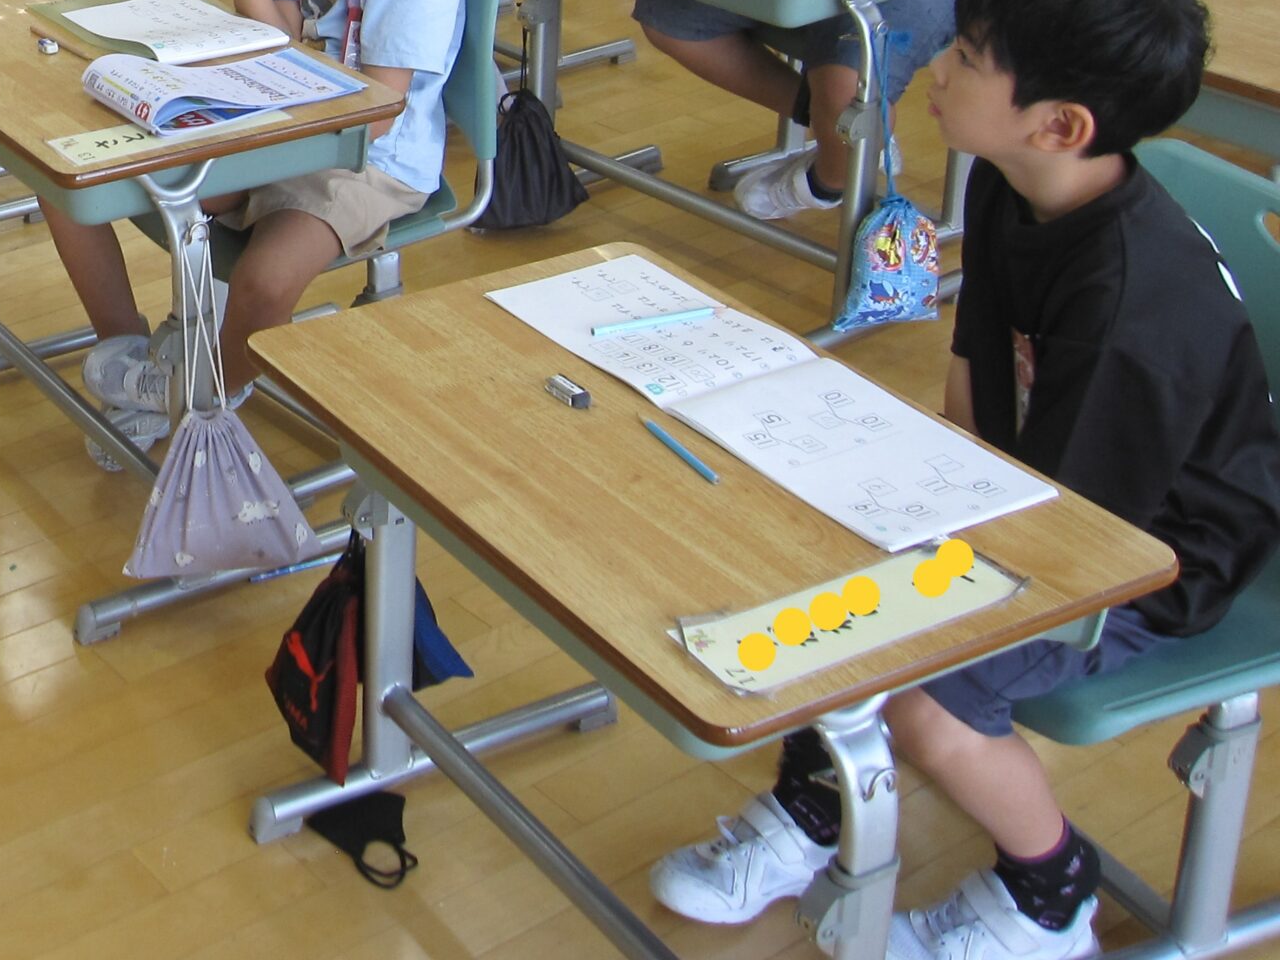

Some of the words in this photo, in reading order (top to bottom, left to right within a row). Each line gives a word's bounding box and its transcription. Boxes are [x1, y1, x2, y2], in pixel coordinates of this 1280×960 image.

[642, 343, 665, 353] 18
[663, 354, 687, 364] 19
[636, 361, 660, 373] 13
[657, 375, 681, 388] 12
[824, 391, 848, 405] 10
[762, 414, 782, 424] 5
[861, 416, 886, 429] 10
[748, 432, 773, 447] 15
[972, 480, 1000, 495] 10
[854, 503, 881, 516] 19
[905, 504, 932, 518] 10
[725, 667, 756, 685] 17
